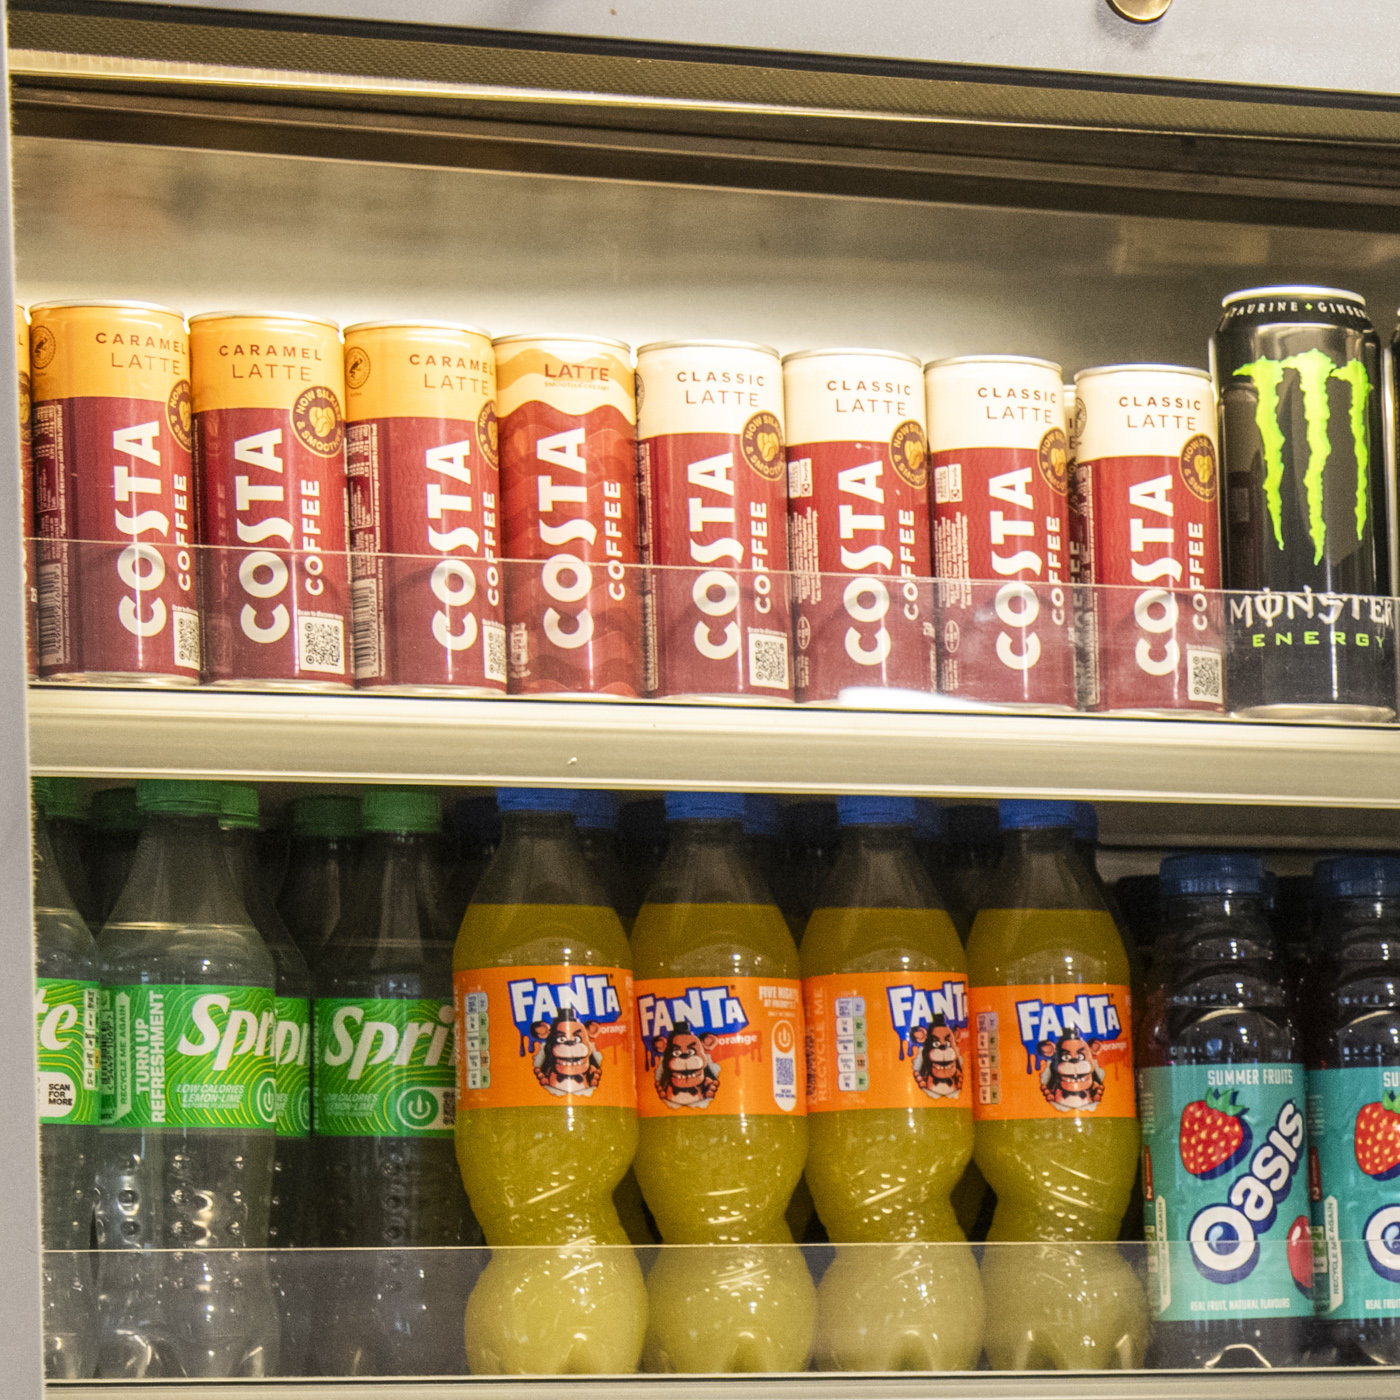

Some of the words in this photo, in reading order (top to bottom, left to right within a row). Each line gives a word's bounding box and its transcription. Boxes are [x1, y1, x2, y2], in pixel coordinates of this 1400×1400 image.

[1230, 302, 1299, 318] TAURINE
[95, 332, 187, 355] CARAMEL
[218, 344, 322, 361] CARAMEL
[111, 352, 181, 376] LATTE
[232, 363, 313, 382] LATTE
[409, 354, 494, 376] CARAMEL
[544, 363, 609, 382] LATTE
[677, 371, 765, 387] CLASSIC
[424, 373, 489, 396] LATTE
[685, 390, 759, 407] LATTE
[827, 380, 911, 396] CLASSIC
[977, 387, 1057, 404] CLASSIC
[835, 398, 906, 417] LATTE
[986, 405, 1053, 424] LATTE
[1119, 396, 1201, 411] CLASSIC
[1127, 414, 1197, 432] LATTE
[112, 420, 170, 637] COSTA
[173, 473, 192, 592] COFFEE
[234, 428, 294, 644] COSTA
[300, 479, 324, 596] COFFEE
[425, 439, 480, 651] COSTA
[536, 427, 597, 649] COSTA
[603, 480, 626, 601] COFFEE
[482, 491, 500, 606] COFFEE
[687, 452, 744, 660] COSTA
[750, 501, 772, 614] COFFEE
[837, 460, 894, 666] COSTA
[899, 509, 919, 621] COFFEE
[988, 467, 1043, 670] COSTA
[1046, 515, 1065, 626] COFFEE
[1129, 474, 1183, 676] COSTA
[1188, 522, 1208, 631] COFFEE
[1229, 585, 1394, 628] MONSTER
[1252, 631, 1383, 648] ENERGY
[510, 974, 621, 1023] FANTA
[638, 987, 746, 1037] FANTA
[119, 1004, 127, 1038] AGAIN
[135, 1018, 149, 1042] UP
[1017, 996, 1121, 1042] FANTA
[119, 1042, 127, 1057] ME
[149, 990, 166, 1123] REFRESHMENT
[324, 1005, 456, 1080] Spri
[717, 1034, 758, 1047] orange
[48, 1083, 70, 1091] SCAN
[119, 1060, 128, 1104] RECYCLE
[135, 1046, 149, 1095] TURN
[1207, 1069, 1260, 1086] SUMMER
[1262, 1068, 1294, 1084] FRUITS
[48, 1091, 66, 1099] FOR
[48, 1098, 73, 1106] MORE
[1189, 1101, 1304, 1272] Oasis
[1327, 1202, 1335, 1233] AGAIN
[1330, 1235, 1337, 1250] ME
[1331, 1252, 1340, 1295] RECYCLE
